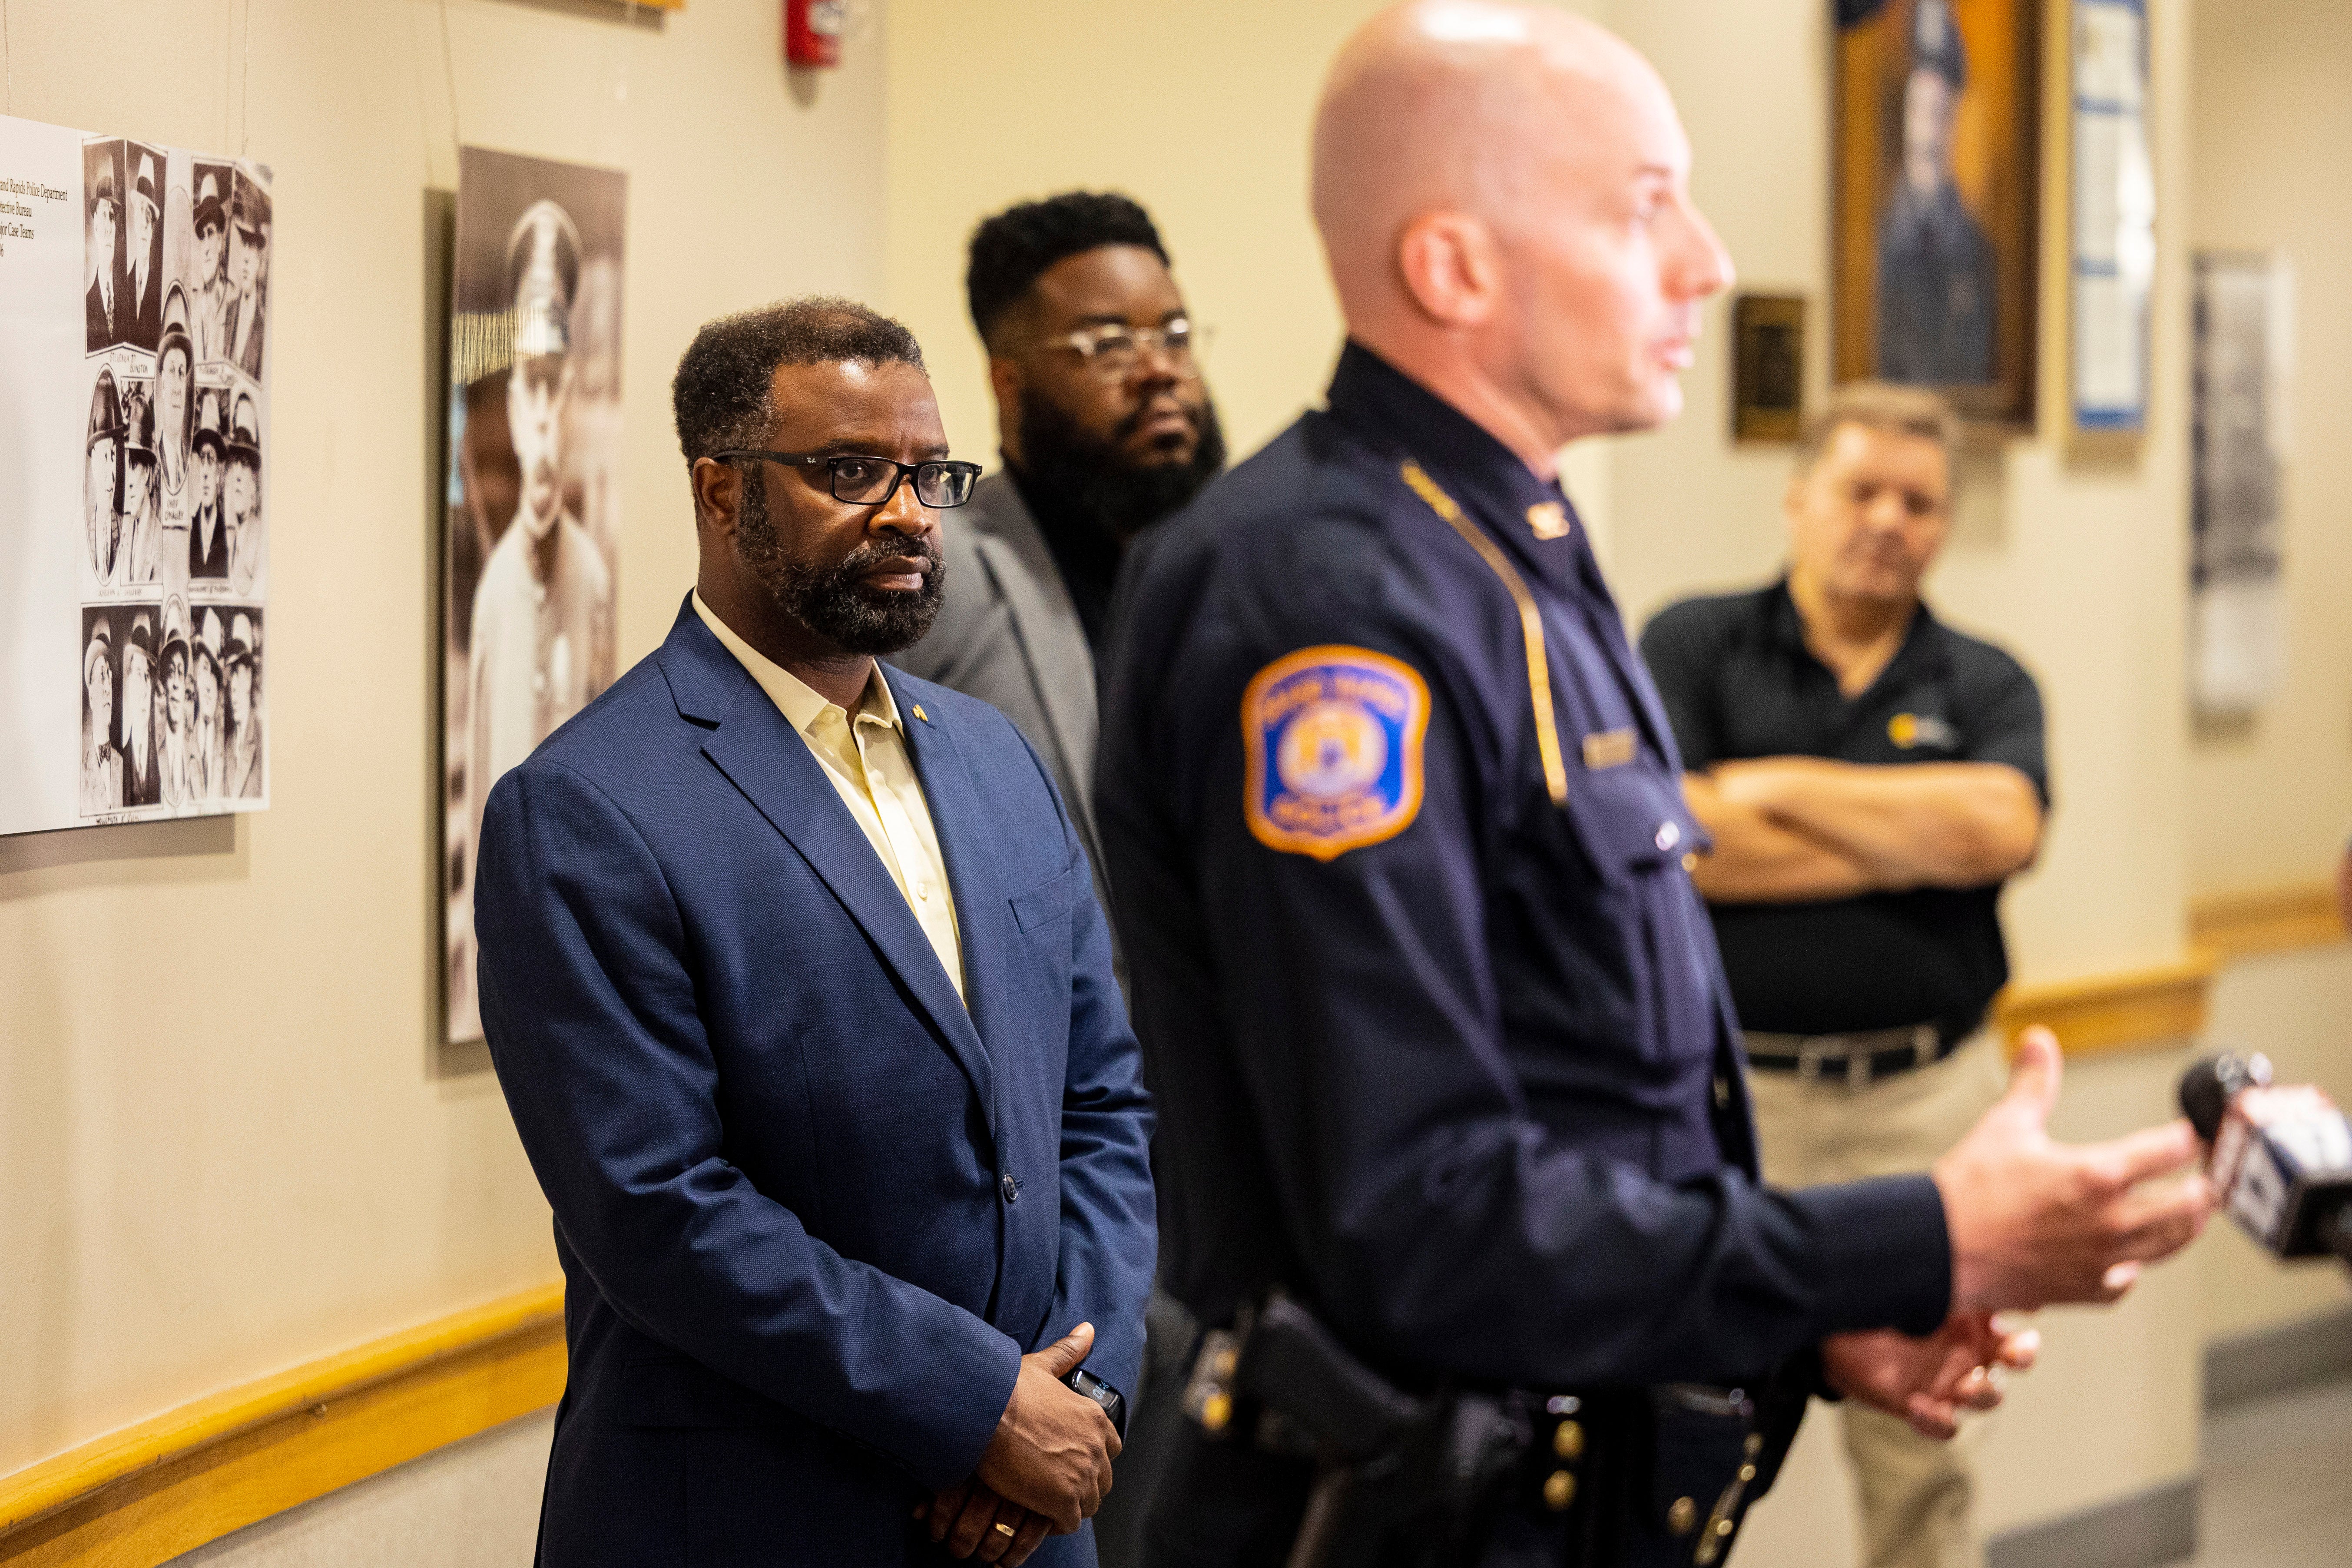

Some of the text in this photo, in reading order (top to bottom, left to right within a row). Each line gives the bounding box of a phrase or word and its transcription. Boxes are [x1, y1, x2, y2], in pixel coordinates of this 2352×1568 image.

[0, 178, 67, 203] and Rapids Police Department
[0, 201, 32, 217] tective Bureau
[8, 222, 19, 237] Case
[20, 224, 34, 239] Teams
[0, 243, 3, 257] 6
